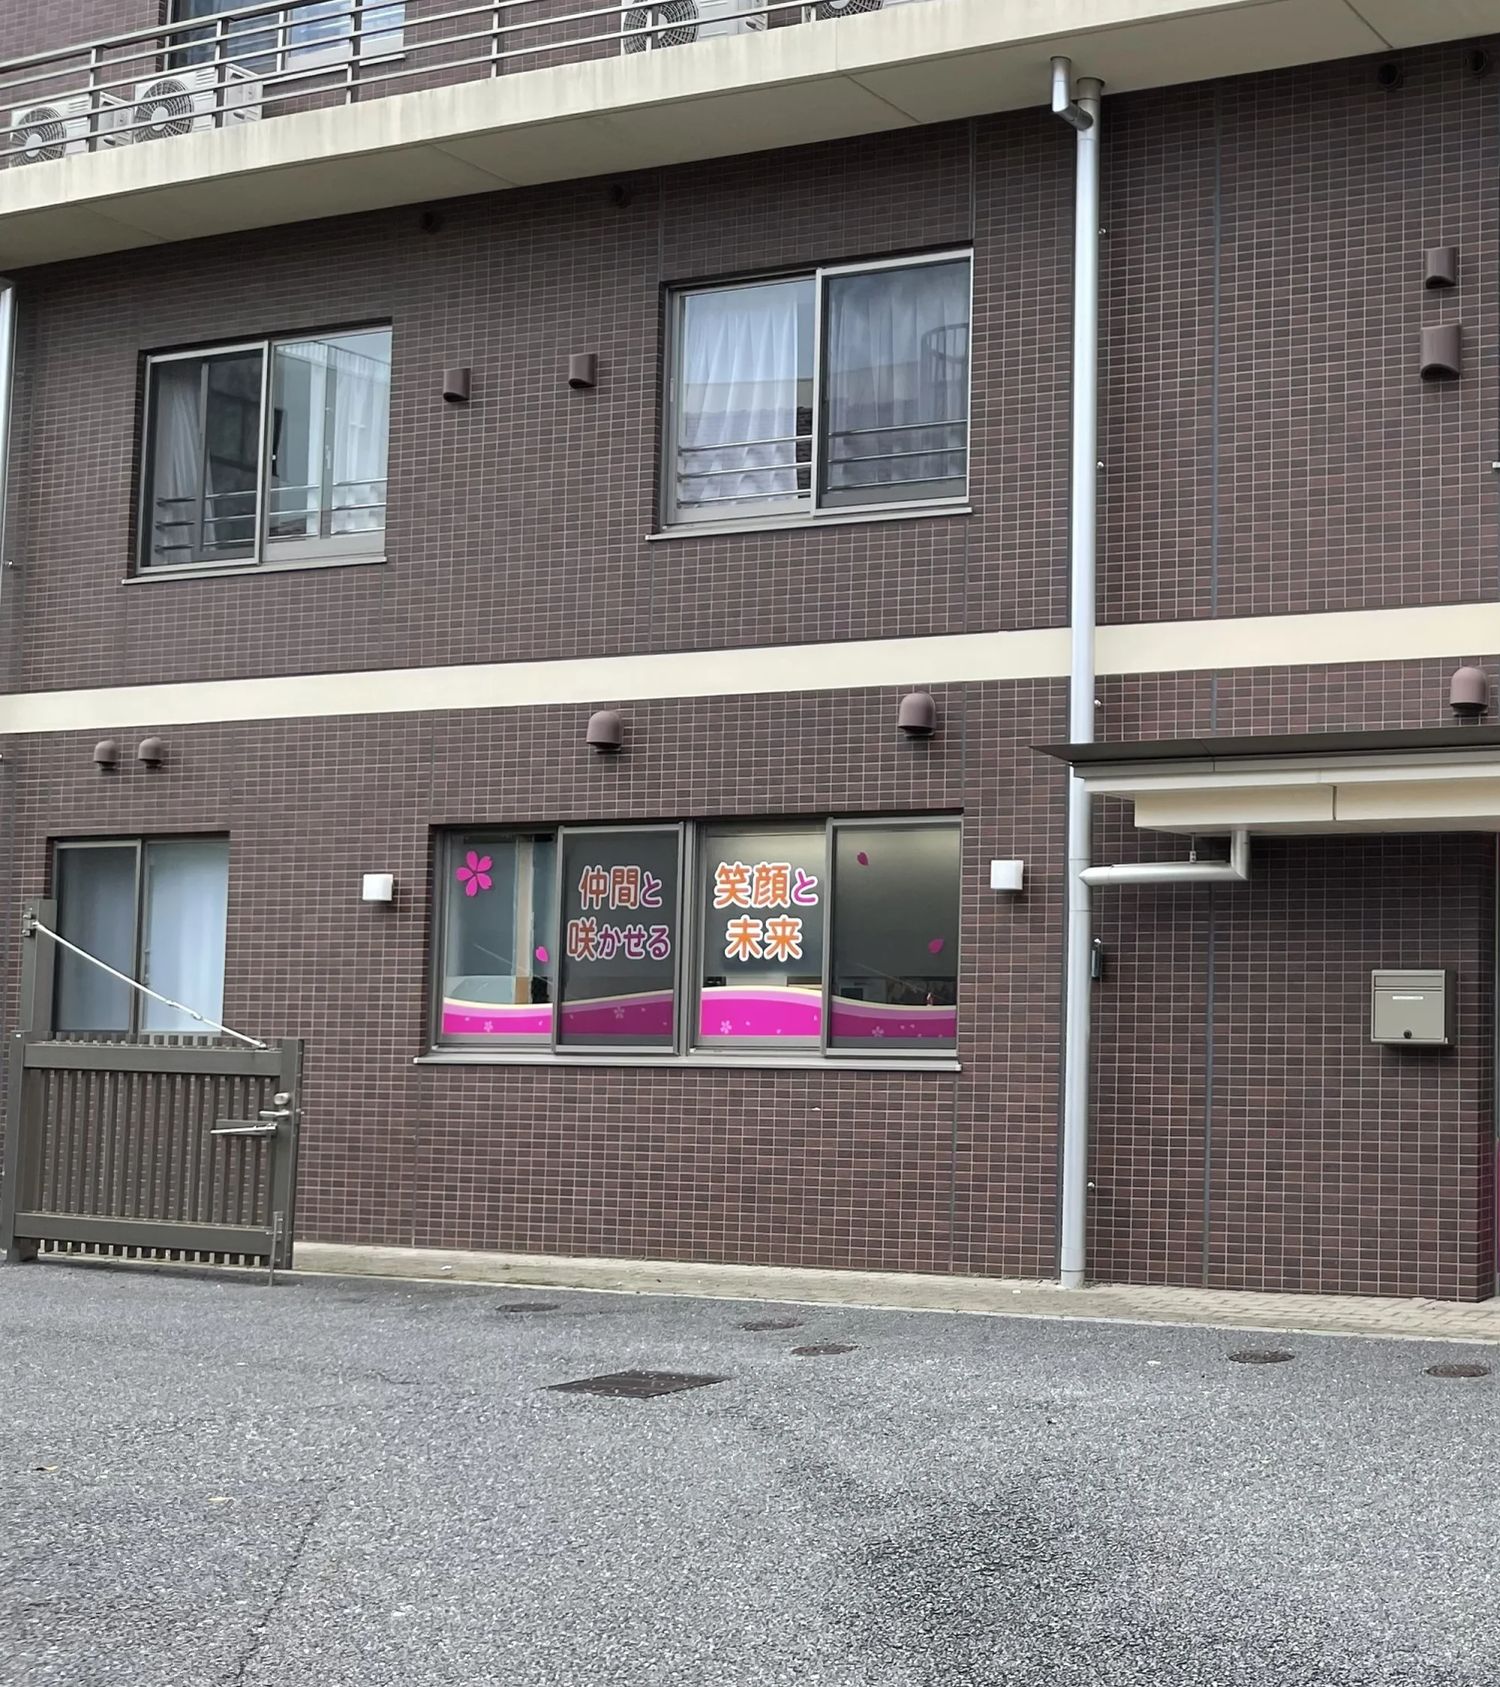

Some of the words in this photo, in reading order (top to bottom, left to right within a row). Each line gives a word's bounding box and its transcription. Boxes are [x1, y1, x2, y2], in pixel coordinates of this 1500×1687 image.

[578, 866, 663, 910] 仲間と
[712, 861, 819, 909] 笑顔と
[567, 918, 670, 962] 咲かせる
[724, 915, 803, 962] 未来
